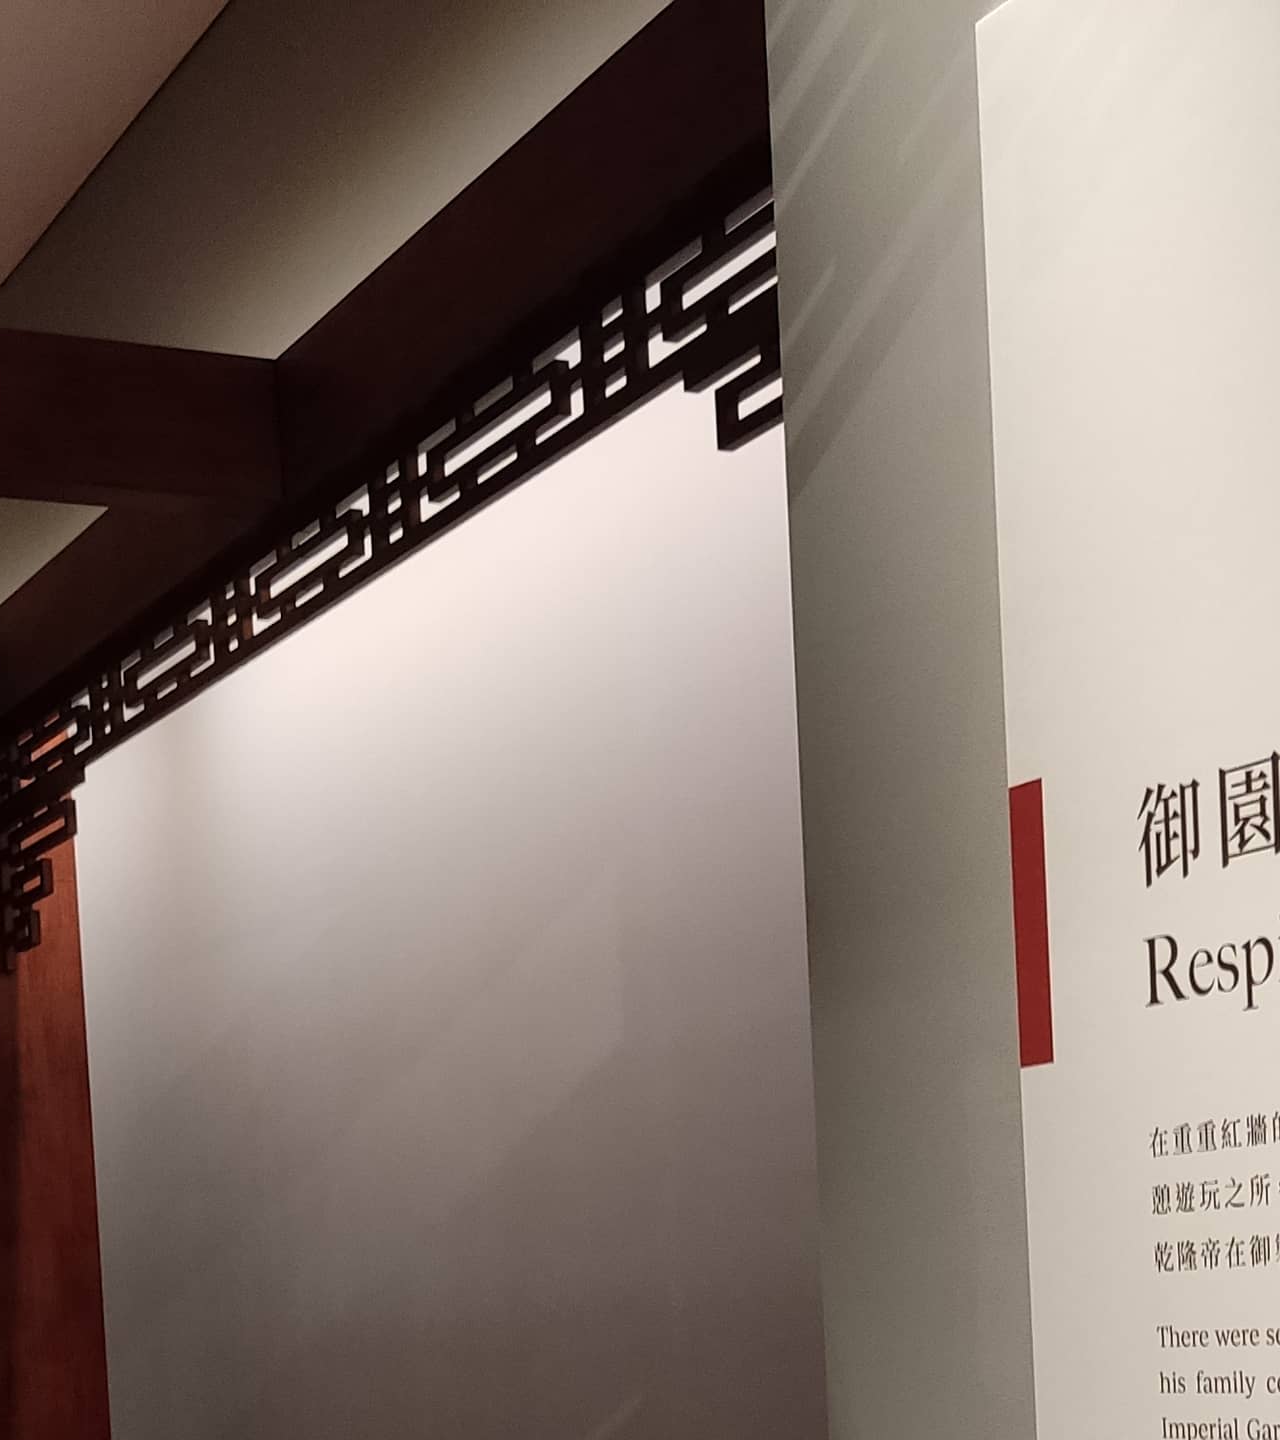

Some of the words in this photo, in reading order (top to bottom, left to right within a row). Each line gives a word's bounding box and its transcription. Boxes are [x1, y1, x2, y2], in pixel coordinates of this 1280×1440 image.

[1156, 1324, 1209, 1349] There
[1214, 1328, 1260, 1348] were
[1159, 1370, 1186, 1394] his
[1196, 1369, 1256, 1400] family
